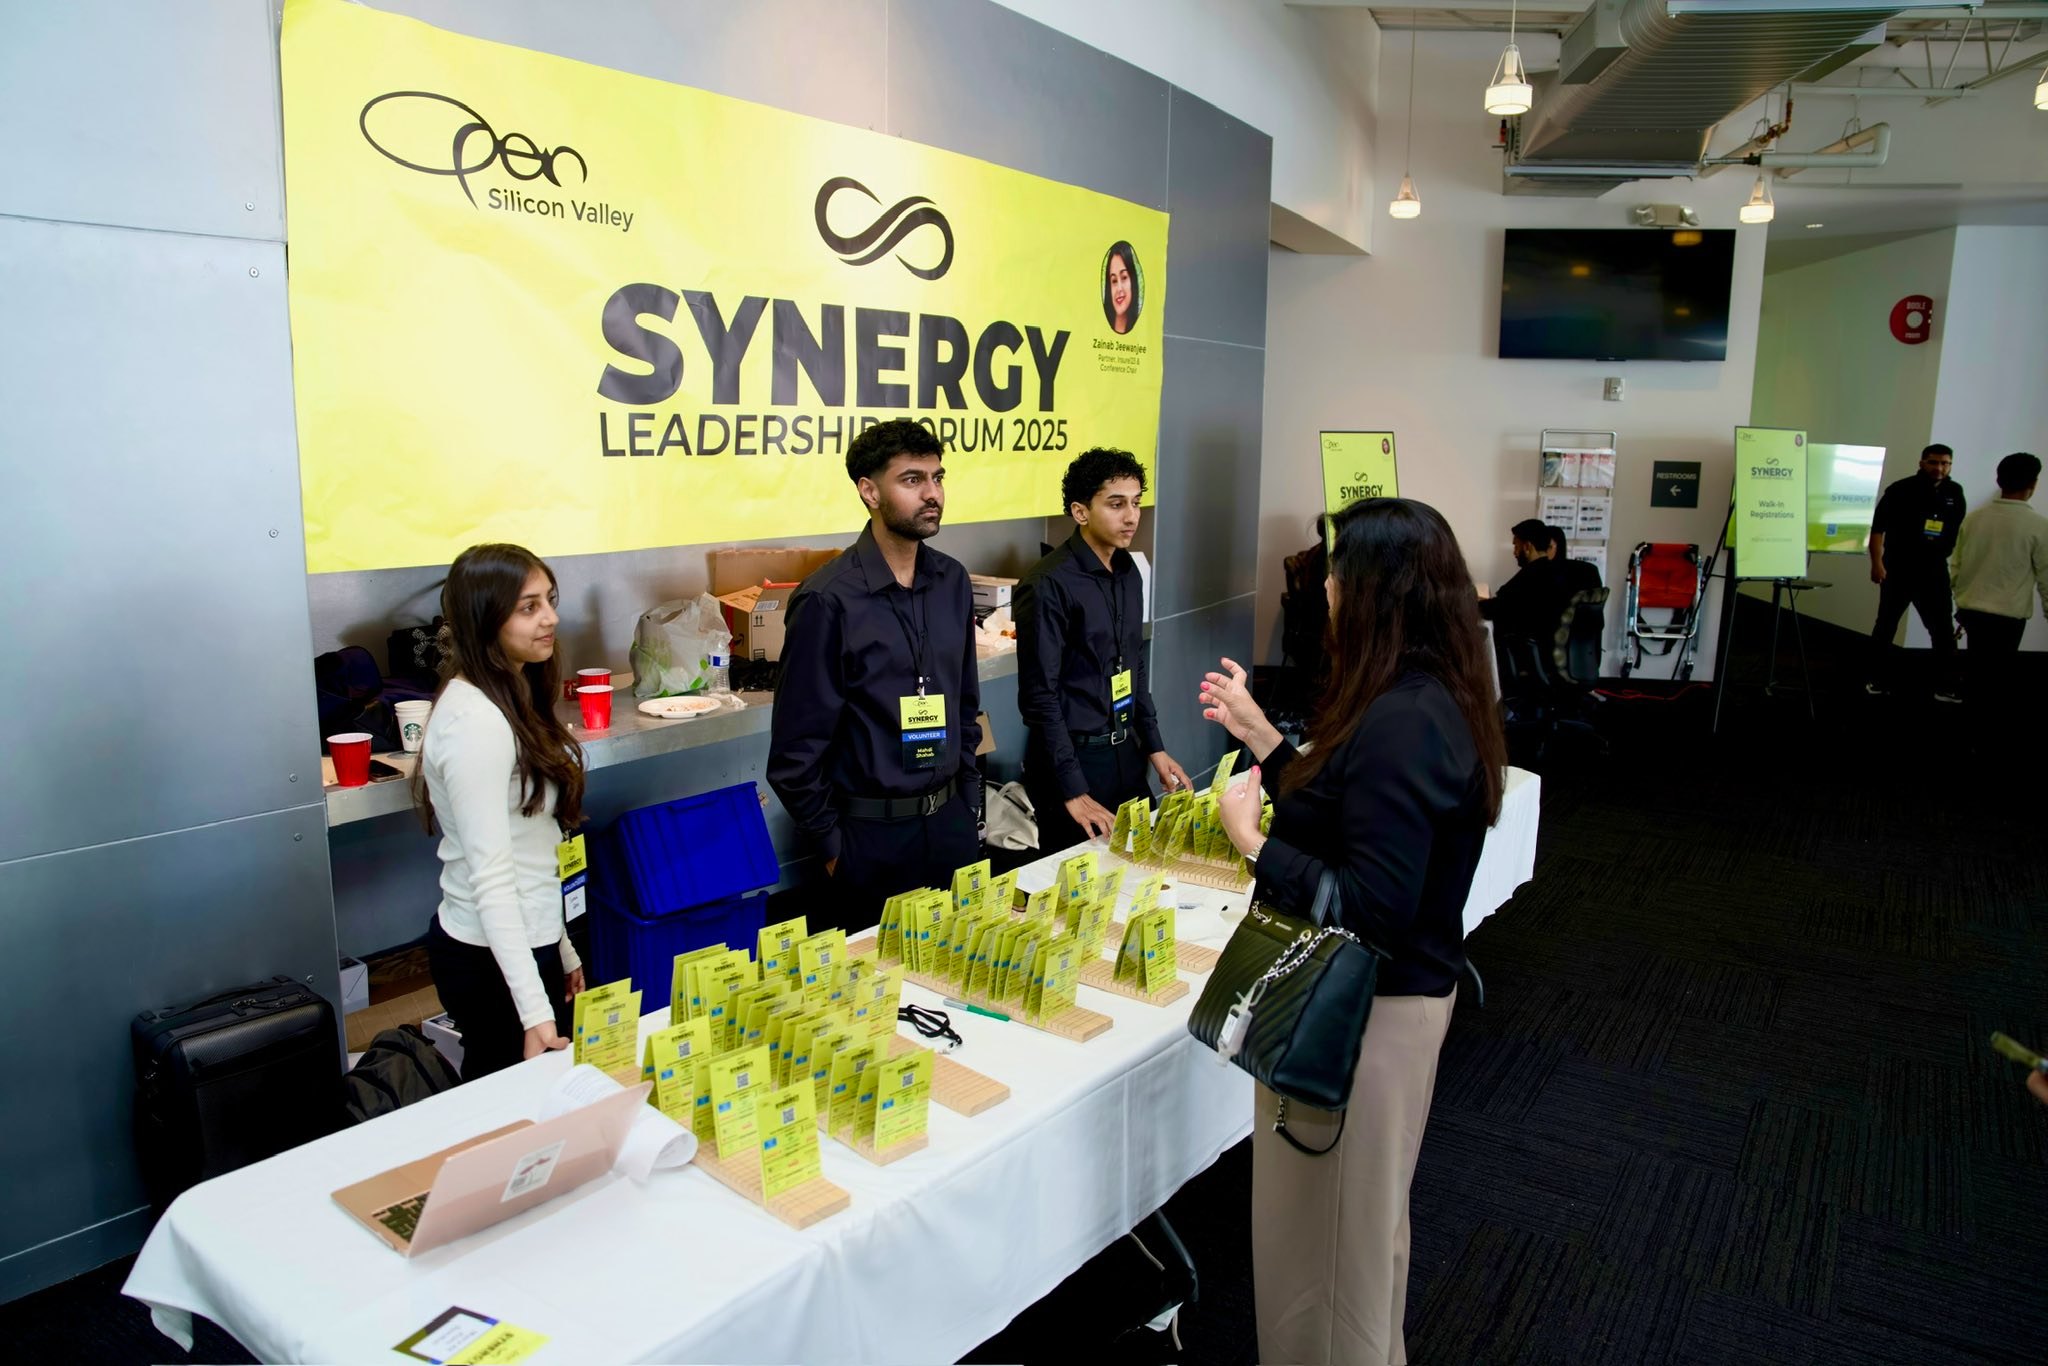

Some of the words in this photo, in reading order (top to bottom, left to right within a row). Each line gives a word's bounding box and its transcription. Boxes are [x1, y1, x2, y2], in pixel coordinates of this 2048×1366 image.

[359, 90, 588, 210] Open
[487, 188, 565, 219] Silicon
[571, 200, 634, 232] Valley
[597, 282, 1071, 413] SYNERGY
[896, 415, 1003, 452] RUM
[1013, 418, 1068, 452] 2025
[1656, 472, 1697, 480] RESTROOMS
[1751, 467, 1793, 477] SYNERGY
[1340, 485, 1383, 499] SYNERGY
[1750, 510, 1795, 520] Registrations
[908, 714, 939, 723] SYNERGY
[908, 731, 941, 740] VOLUNTEER
